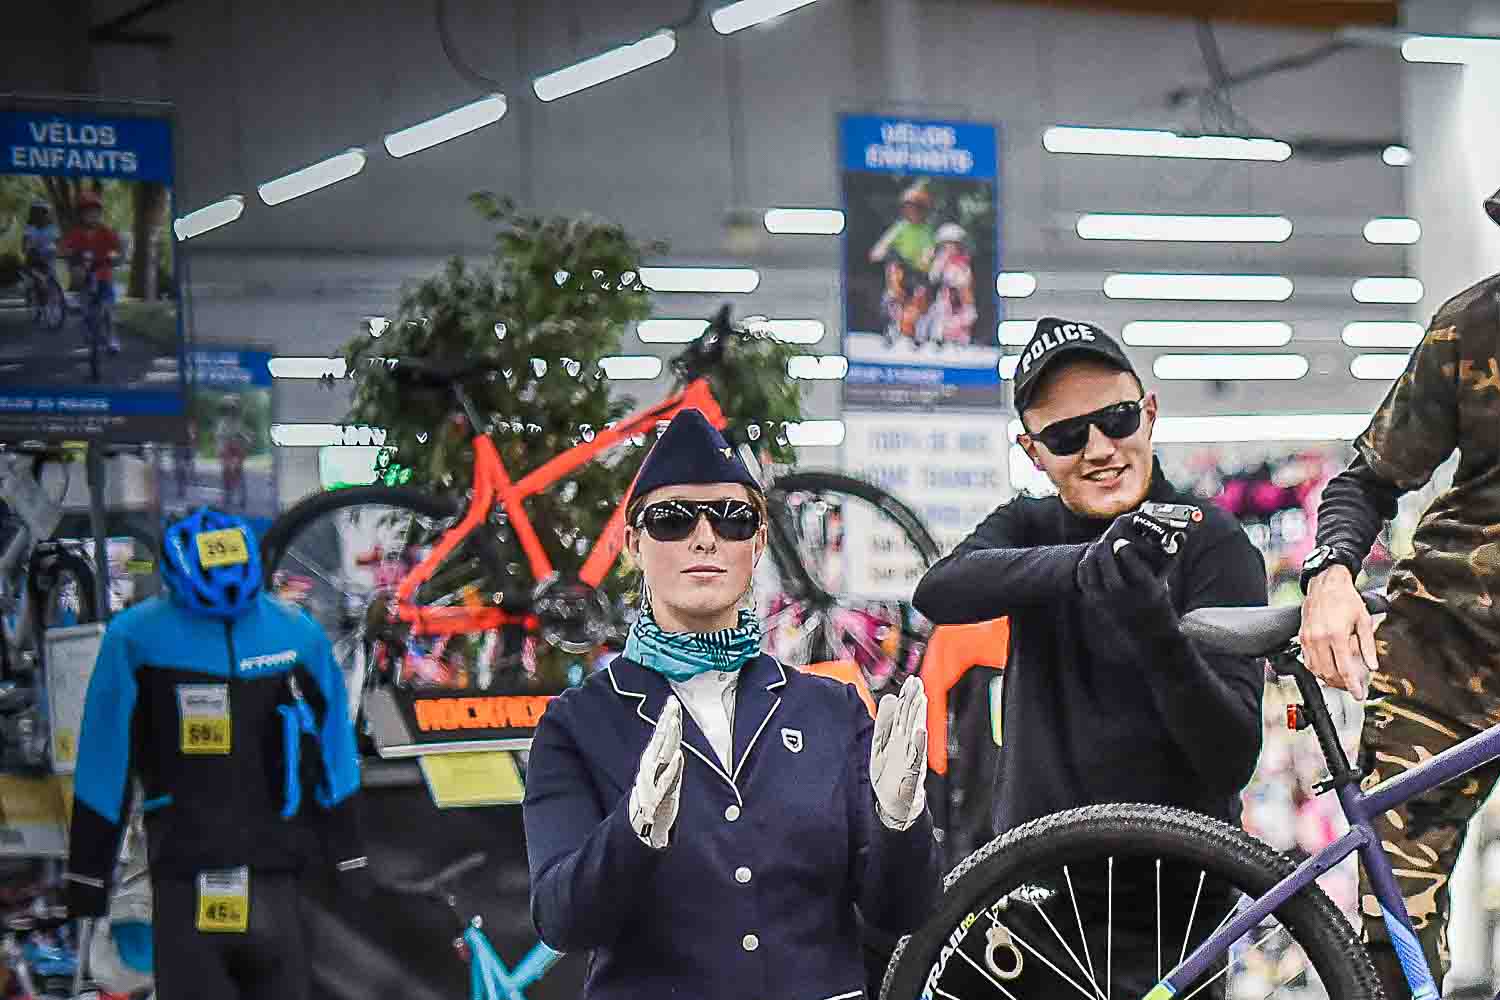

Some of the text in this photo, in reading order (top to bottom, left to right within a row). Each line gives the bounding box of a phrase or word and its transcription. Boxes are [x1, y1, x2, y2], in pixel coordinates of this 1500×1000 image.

[29, 116, 117, 146] VÉLOS
[11, 146, 138, 173] ENFANTS
[1020, 323, 1096, 374] POLICE
